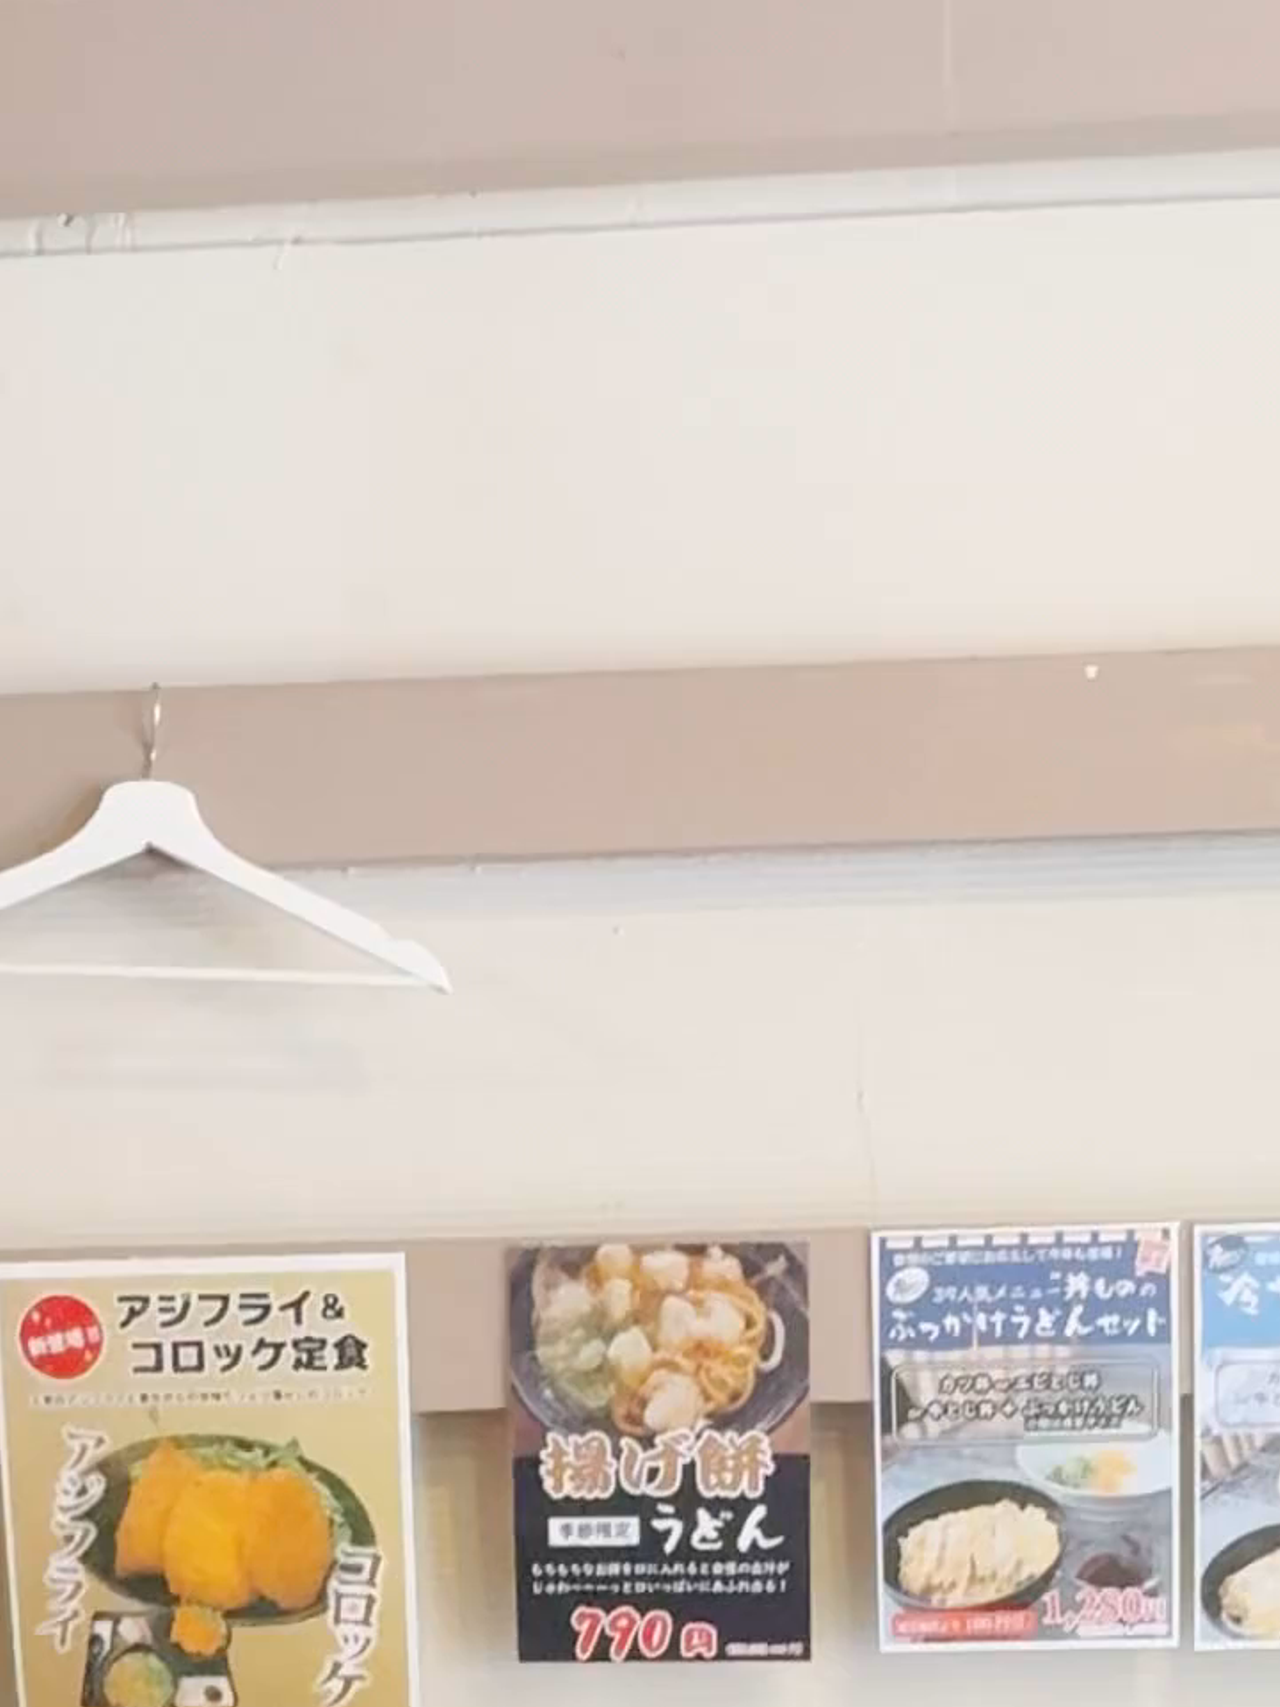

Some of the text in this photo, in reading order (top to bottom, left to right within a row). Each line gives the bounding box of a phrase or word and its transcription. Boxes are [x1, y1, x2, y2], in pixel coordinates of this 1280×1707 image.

[116, 1289, 345, 1329] アジフライ&
[888, 1304, 1167, 1341] ぶっかけうどんセット
[131, 1334, 369, 1375] コロッケ定食
[541, 1430, 774, 1499] 揚げ餅
[35, 1425, 109, 1653] アジフライ
[650, 1503, 785, 1554] うどん
[570, 1605, 719, 1661] 790円
